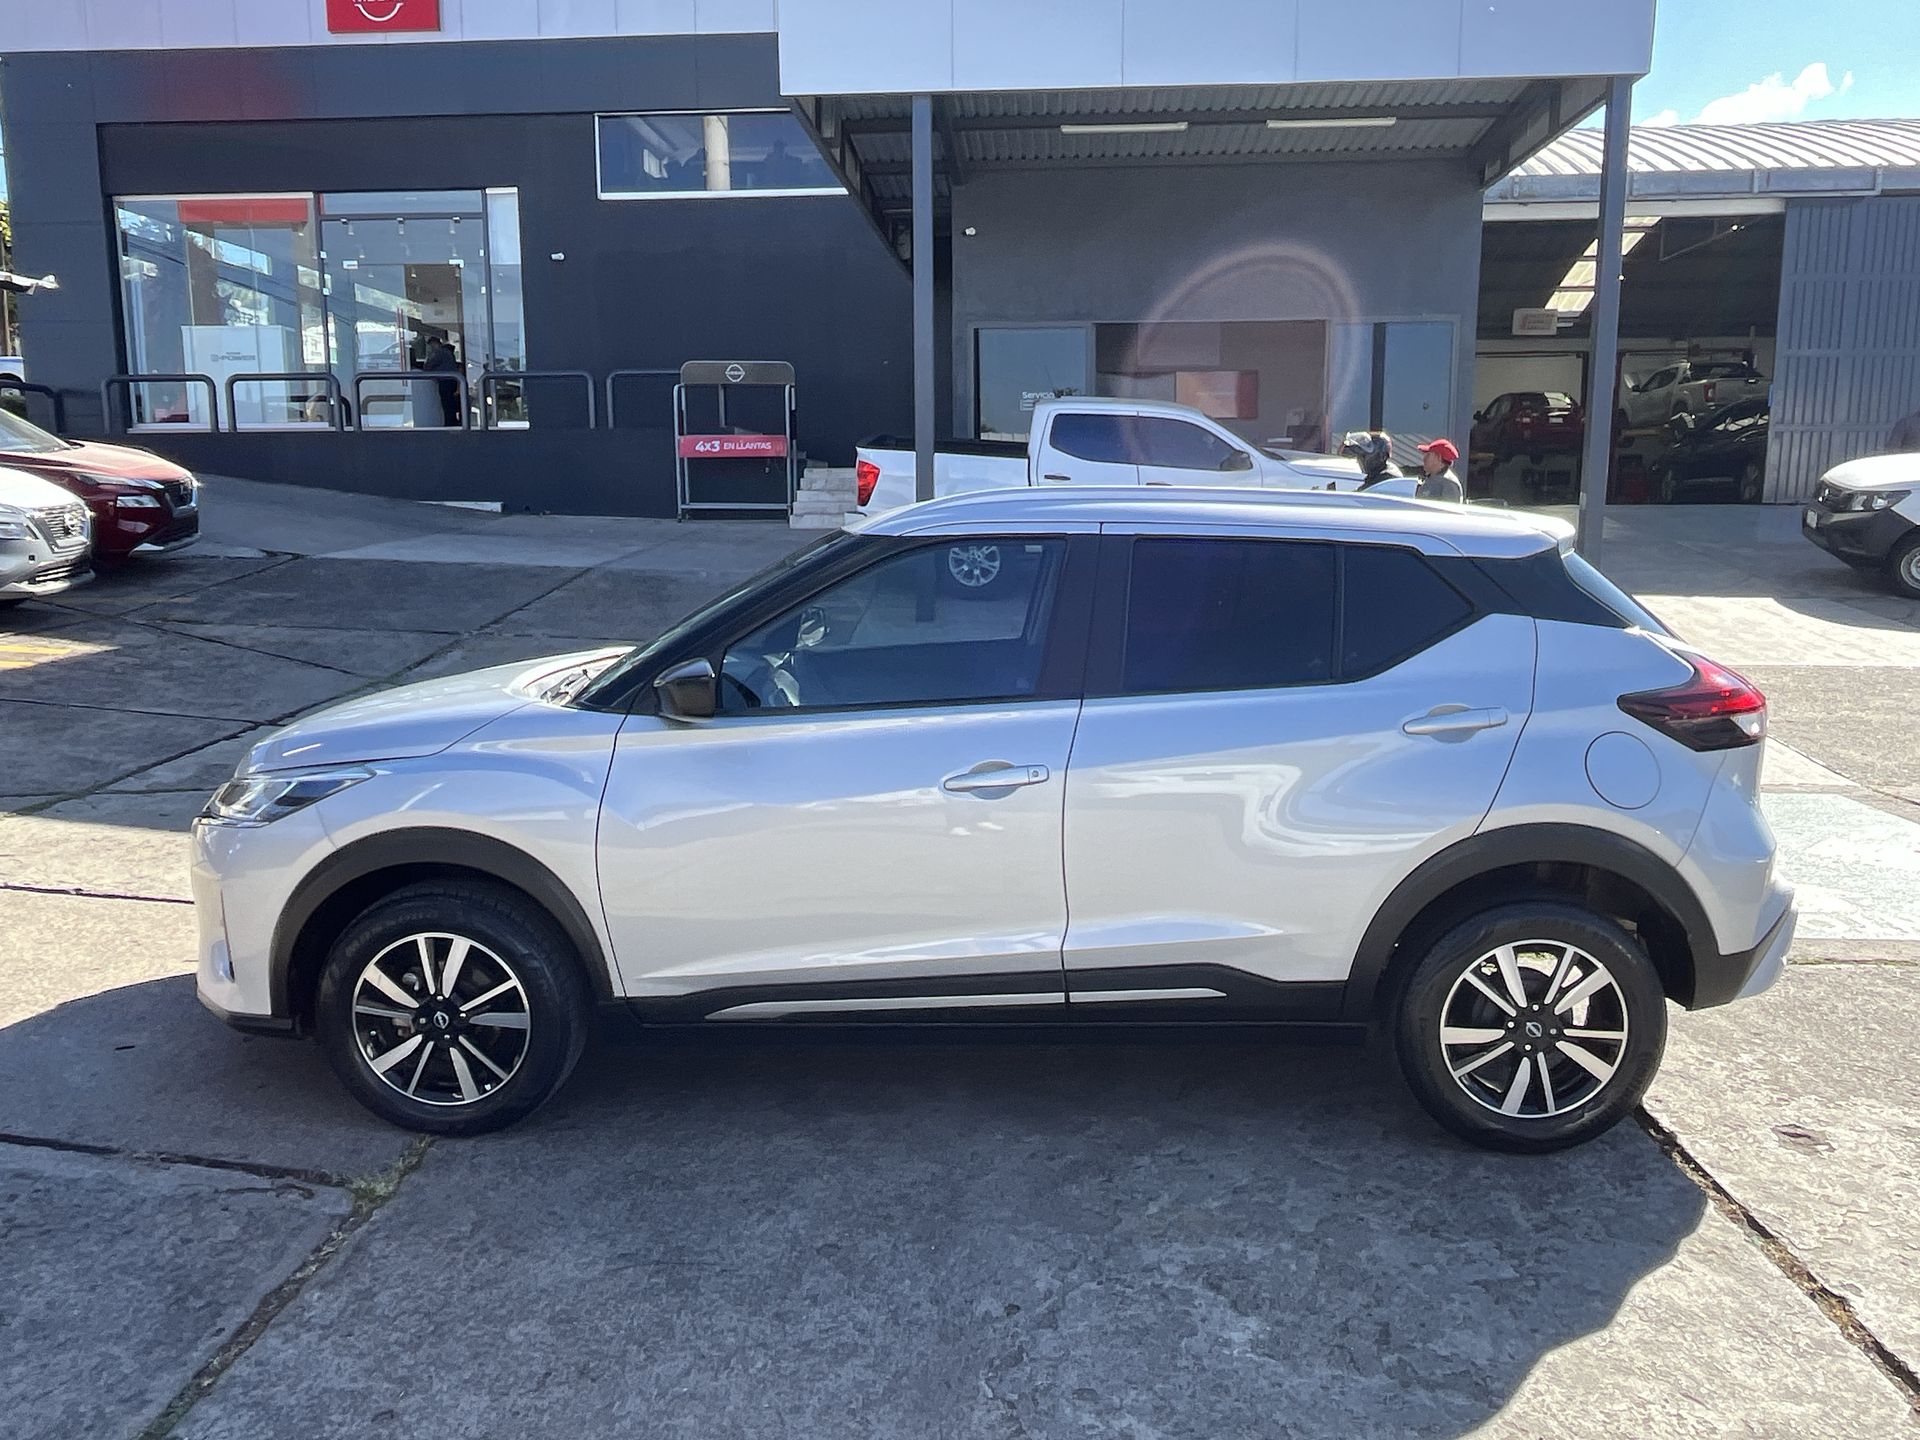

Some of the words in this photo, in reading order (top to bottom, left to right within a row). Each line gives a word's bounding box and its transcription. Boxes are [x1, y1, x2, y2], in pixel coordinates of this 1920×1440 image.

[695, 440, 721, 452] 4x3
[723, 442, 735, 450] EN
[736, 442, 772, 450] LLANTAS
